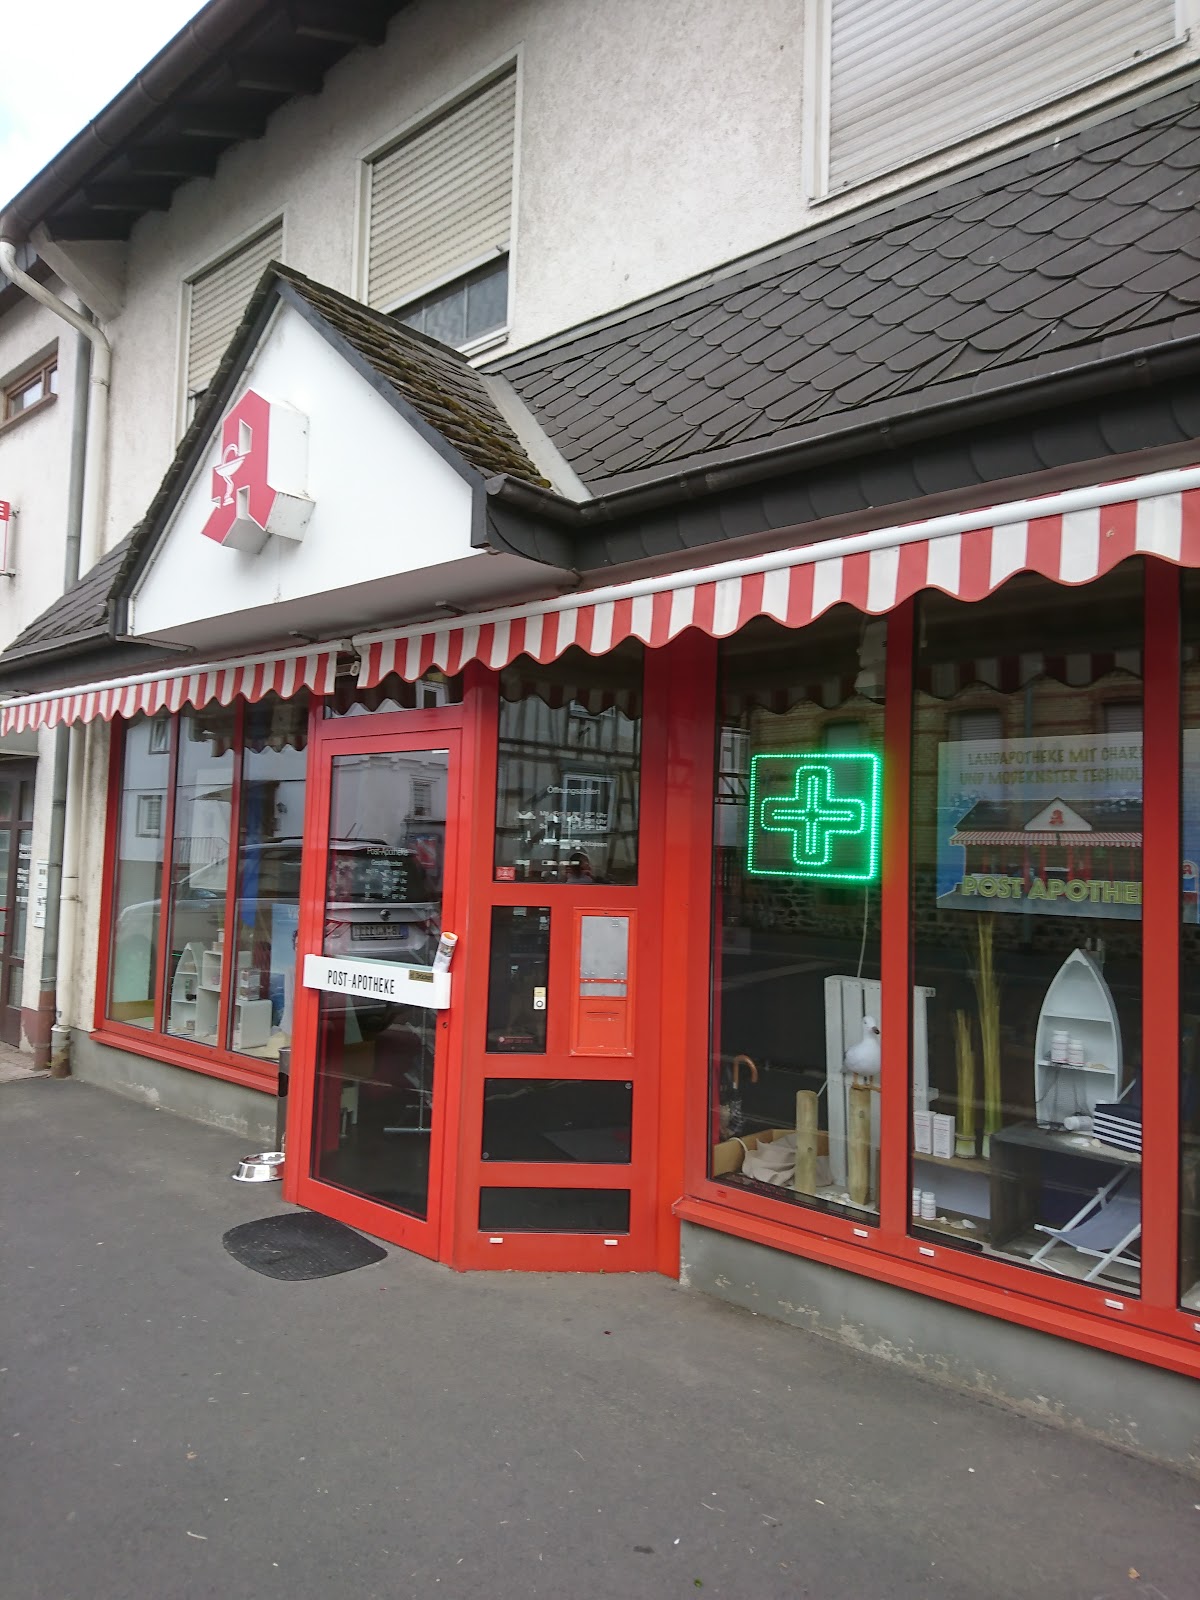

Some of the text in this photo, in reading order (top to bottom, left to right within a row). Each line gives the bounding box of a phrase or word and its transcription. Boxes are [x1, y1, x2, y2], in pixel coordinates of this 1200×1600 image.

[968, 745, 1142, 766] LANDAPOTHEKE MIT CHAR
[960, 772, 984, 785] UND
[988, 769, 1078, 785] MODERNSTER
[961, 875, 1024, 899] POST
[327, 969, 395, 995] POST-APOTHEKE
